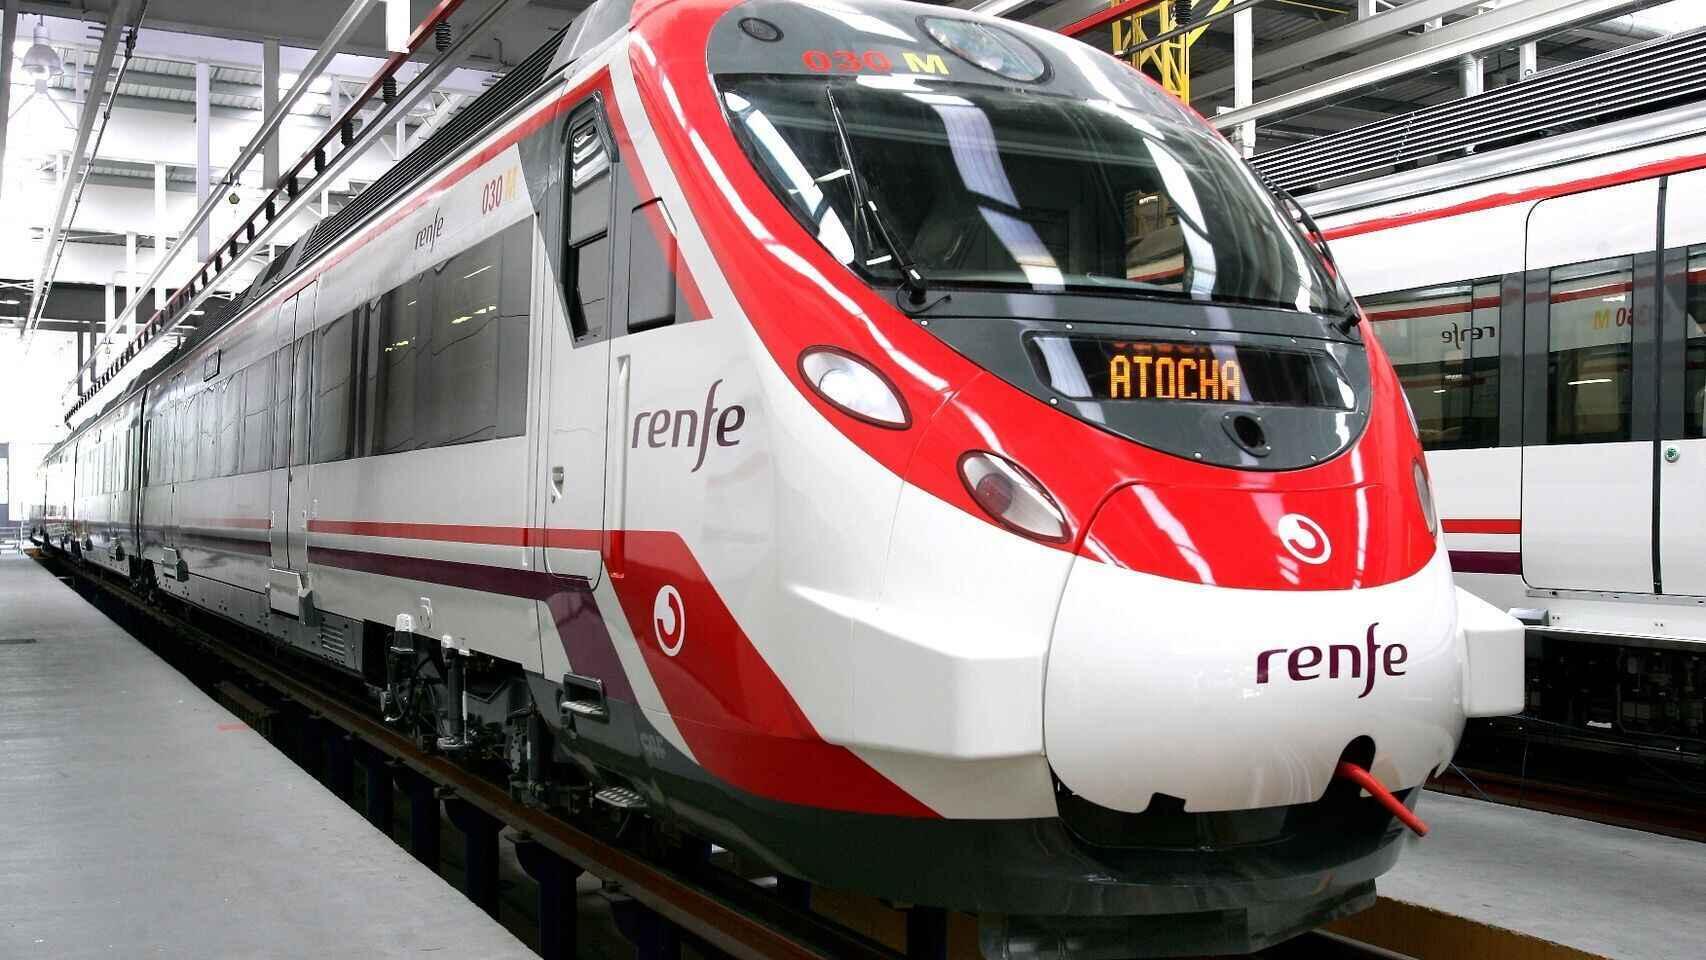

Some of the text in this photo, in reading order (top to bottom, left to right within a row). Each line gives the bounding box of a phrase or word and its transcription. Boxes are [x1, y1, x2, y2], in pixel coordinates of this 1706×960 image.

[802, 49, 950, 75] 030 M
[482, 166, 519, 216] 030 M
[415, 207, 445, 253] renfe
[1110, 355, 1241, 400] ATOCHA
[631, 378, 746, 473] renfe
[1256, 622, 1408, 698] renfe
